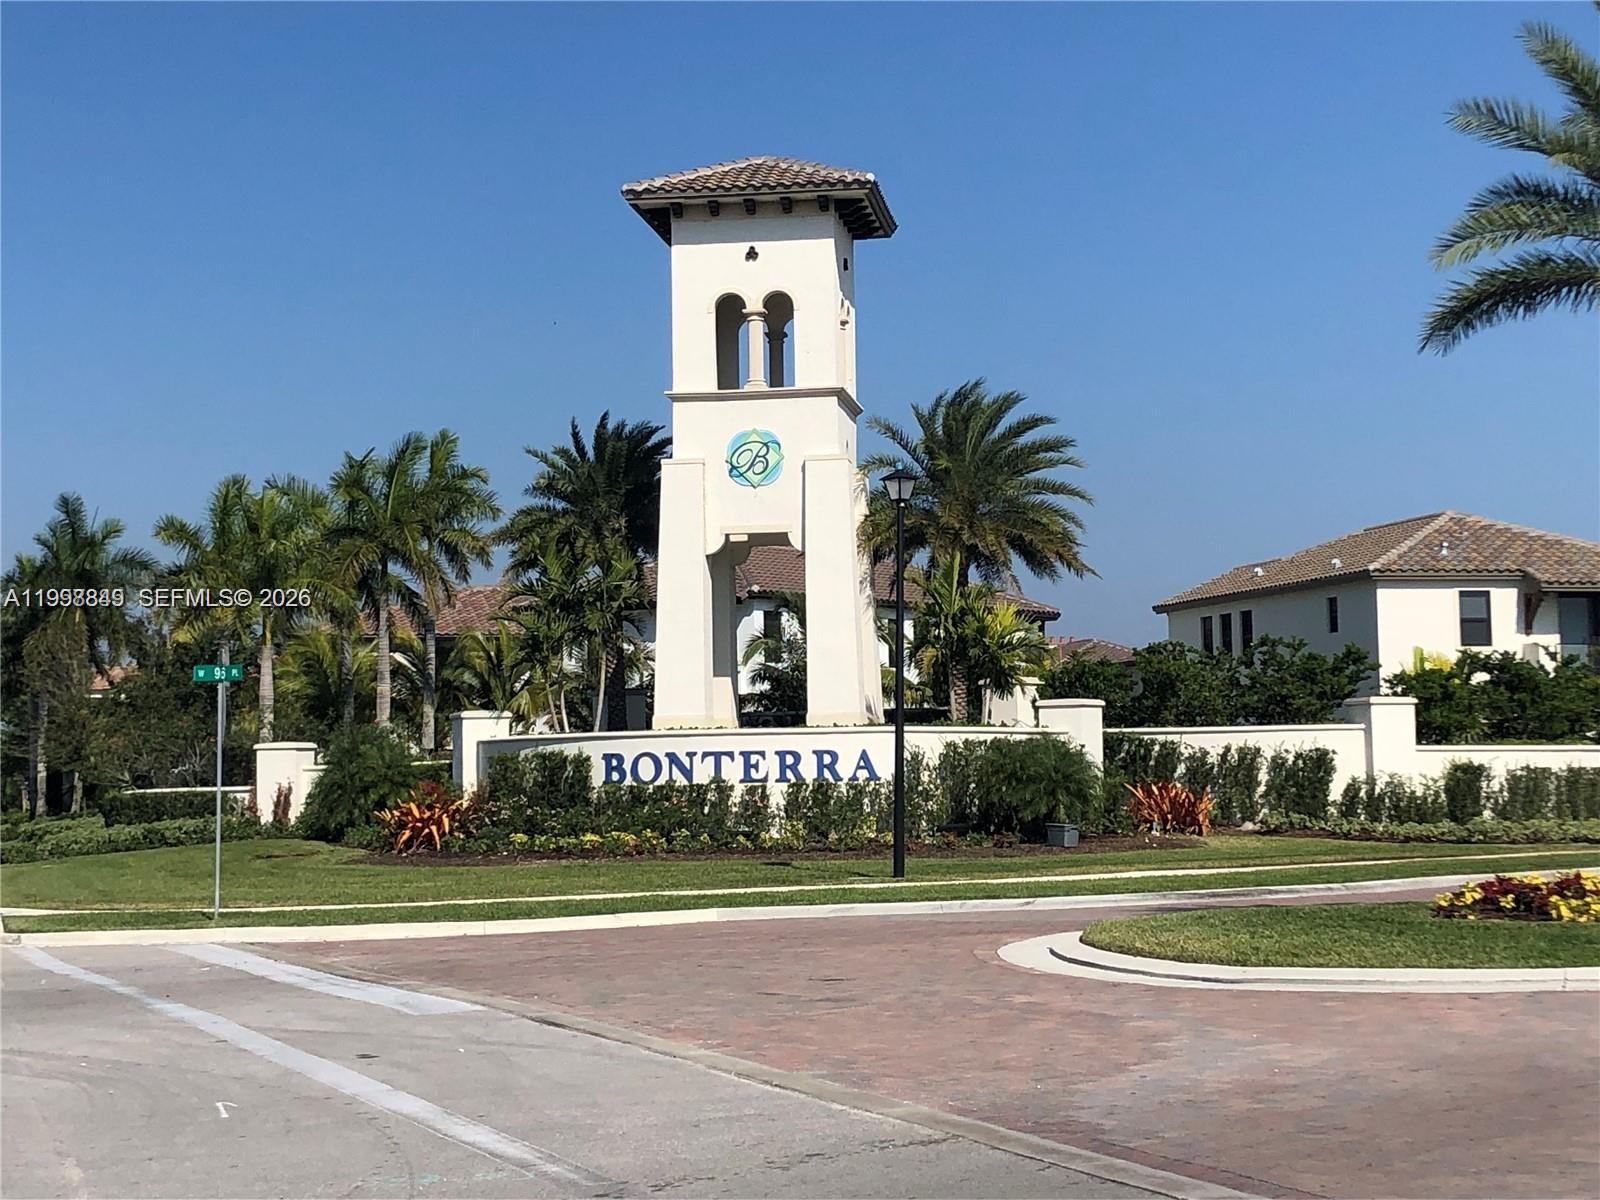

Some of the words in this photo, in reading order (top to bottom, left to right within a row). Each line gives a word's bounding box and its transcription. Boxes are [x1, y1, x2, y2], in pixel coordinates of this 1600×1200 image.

[197, 669, 205, 678] W
[214, 667, 226, 680] 96
[231, 668, 239, 677] PL
[601, 749, 881, 785] BONTERRA
